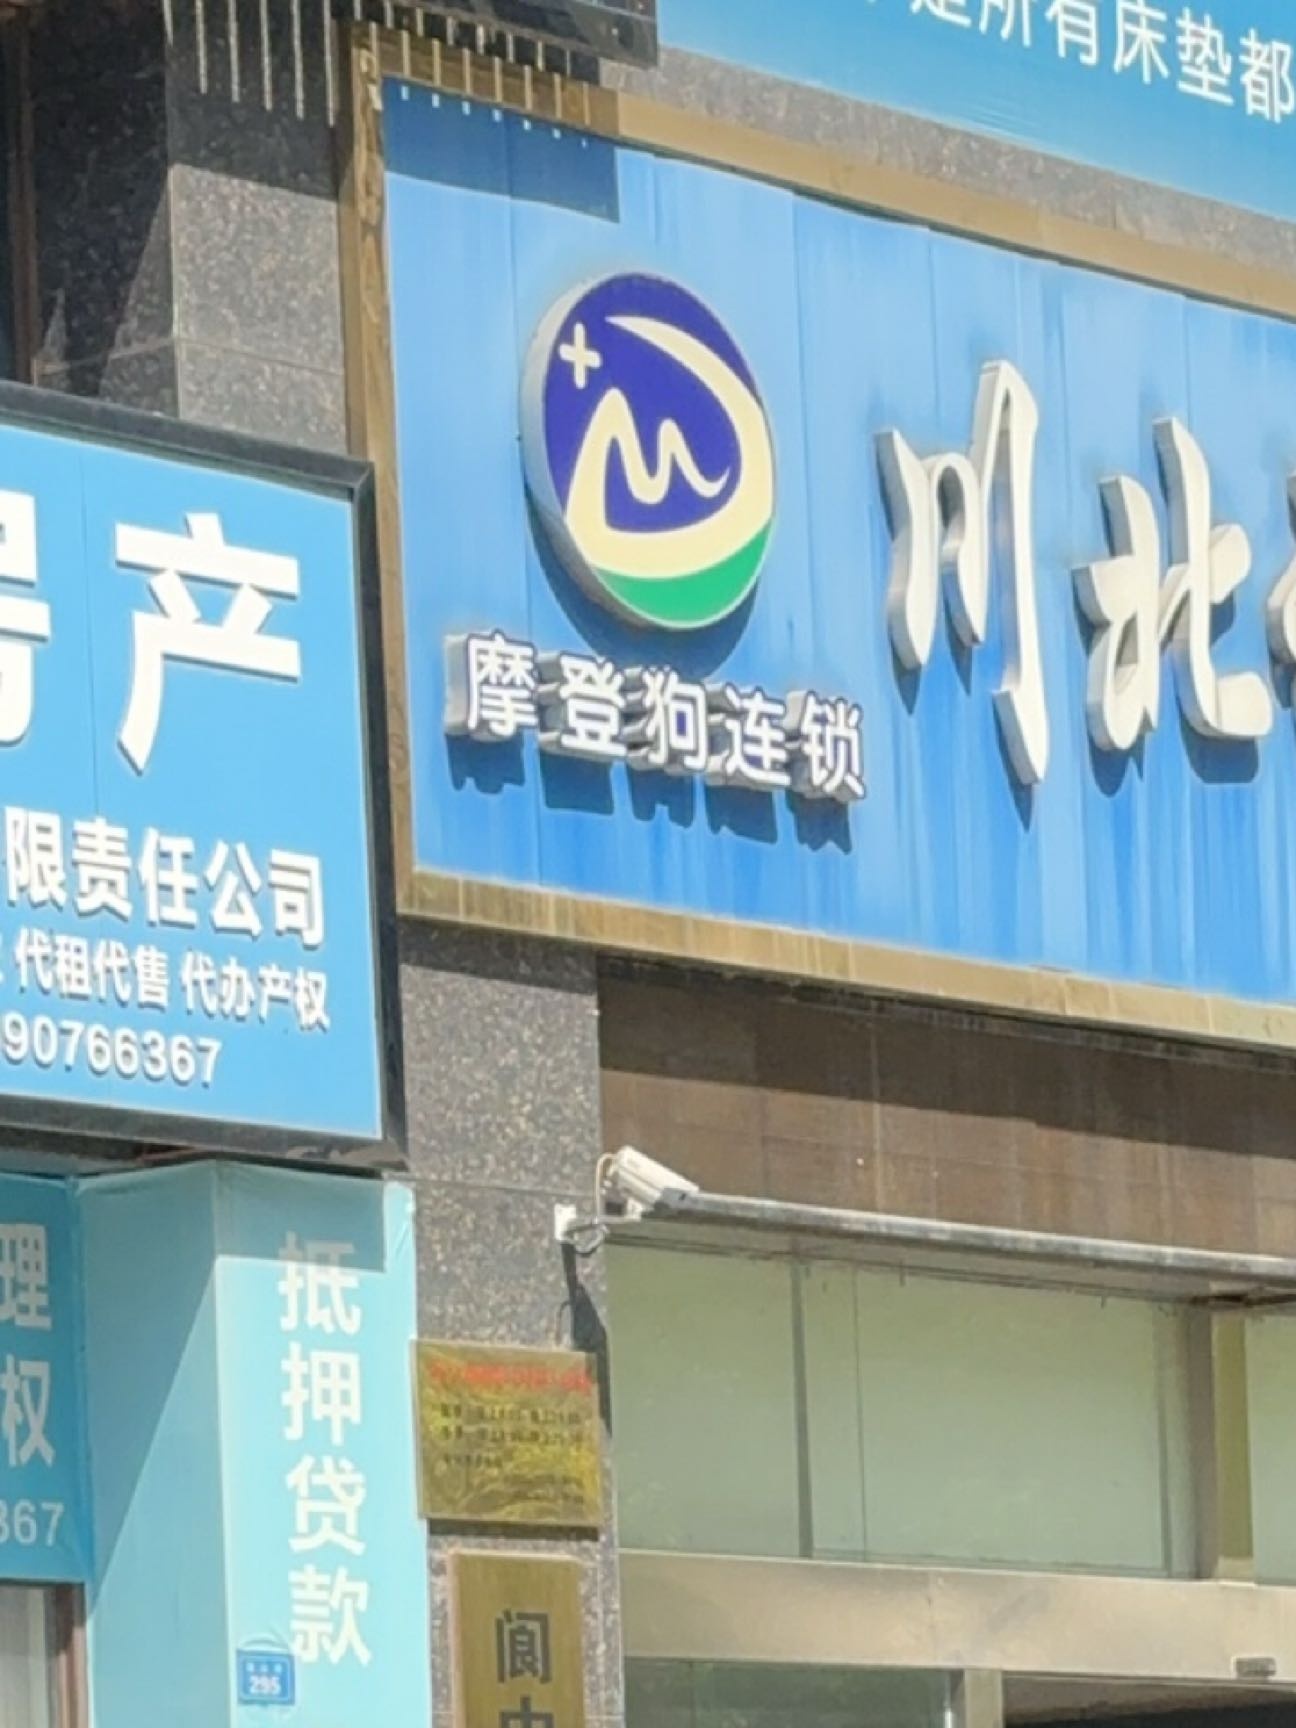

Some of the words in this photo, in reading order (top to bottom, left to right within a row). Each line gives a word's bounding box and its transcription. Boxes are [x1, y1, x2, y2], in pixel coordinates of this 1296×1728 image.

[458, 630, 868, 802] 摩登狗连锁
[3, 805, 326, 951] 限责任公司
[2, 1010, 223, 1089] 90766367
[15, 927, 171, 1012] 代租代售
[181, 948, 331, 1034] 代办产权
[277, 1230, 372, 1667] 抵押贷款
